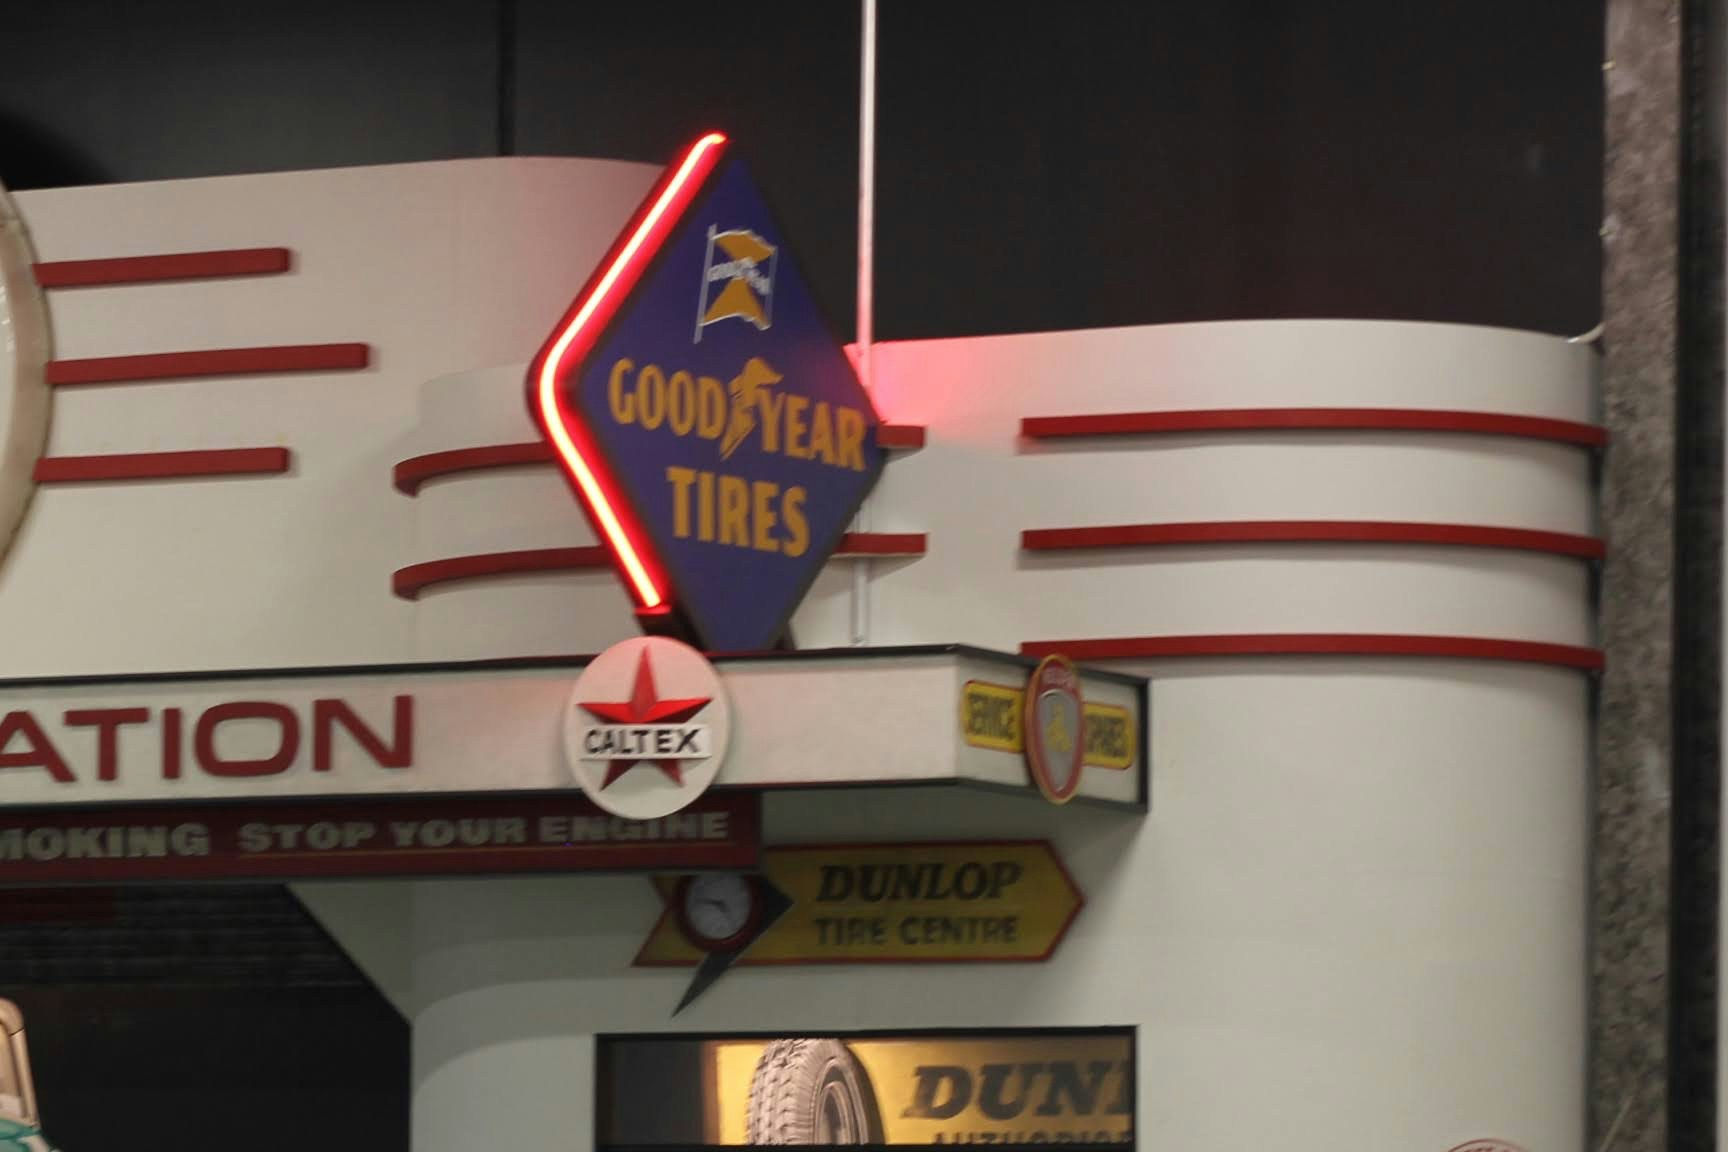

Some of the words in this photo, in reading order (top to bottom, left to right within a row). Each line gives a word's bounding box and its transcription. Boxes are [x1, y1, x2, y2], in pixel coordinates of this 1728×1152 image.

[666, 467, 811, 558] TIRES
[583, 728, 701, 754] CALTEX
[238, 819, 376, 853] STOP
[389, 815, 527, 848] YOUR
[539, 810, 730, 843] ENGINE
[815, 861, 1026, 903] DUNLOP
[813, 916, 889, 946] TIRE
[898, 914, 1020, 946] CENTRE
